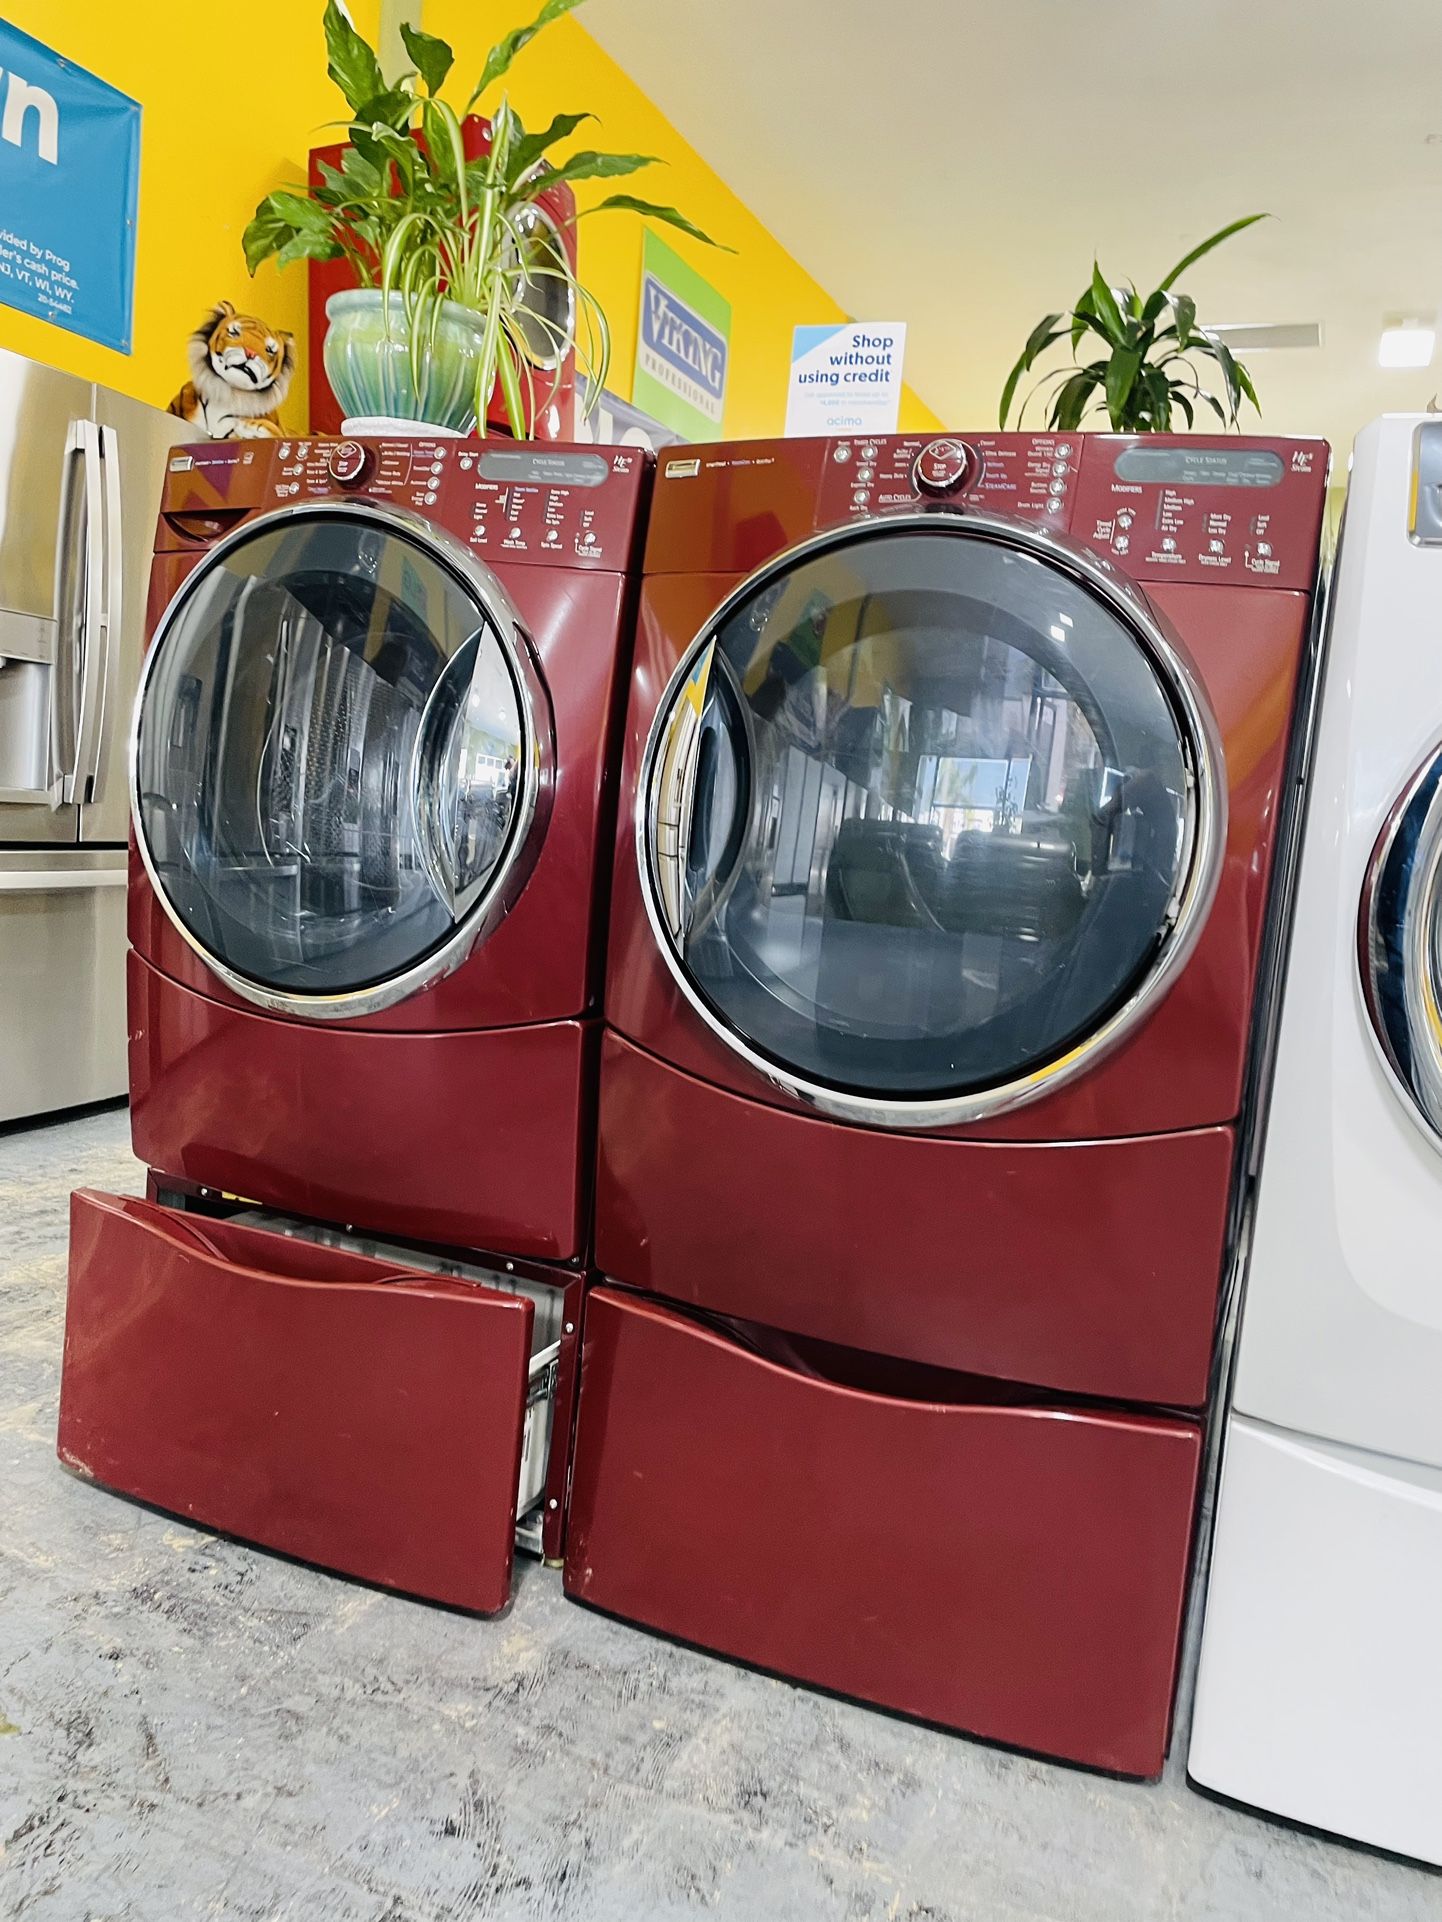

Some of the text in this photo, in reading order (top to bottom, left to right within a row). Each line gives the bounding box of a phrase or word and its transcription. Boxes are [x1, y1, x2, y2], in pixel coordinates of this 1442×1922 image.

[0, 66, 59, 165] n
[24, 258, 49, 276] cash
[30, 242, 43, 259] by
[45, 249, 70, 272] Prog
[16, 268, 32, 286] VT,
[54, 285, 75, 303] WY.
[648, 284, 722, 390] VIKING
[852, 334, 893, 351] Shop
[829, 352, 892, 365] without
[645, 352, 714, 414] PROFESSIONAL
[798, 369, 890, 386] using credit
[826, 416, 863, 426] acima
